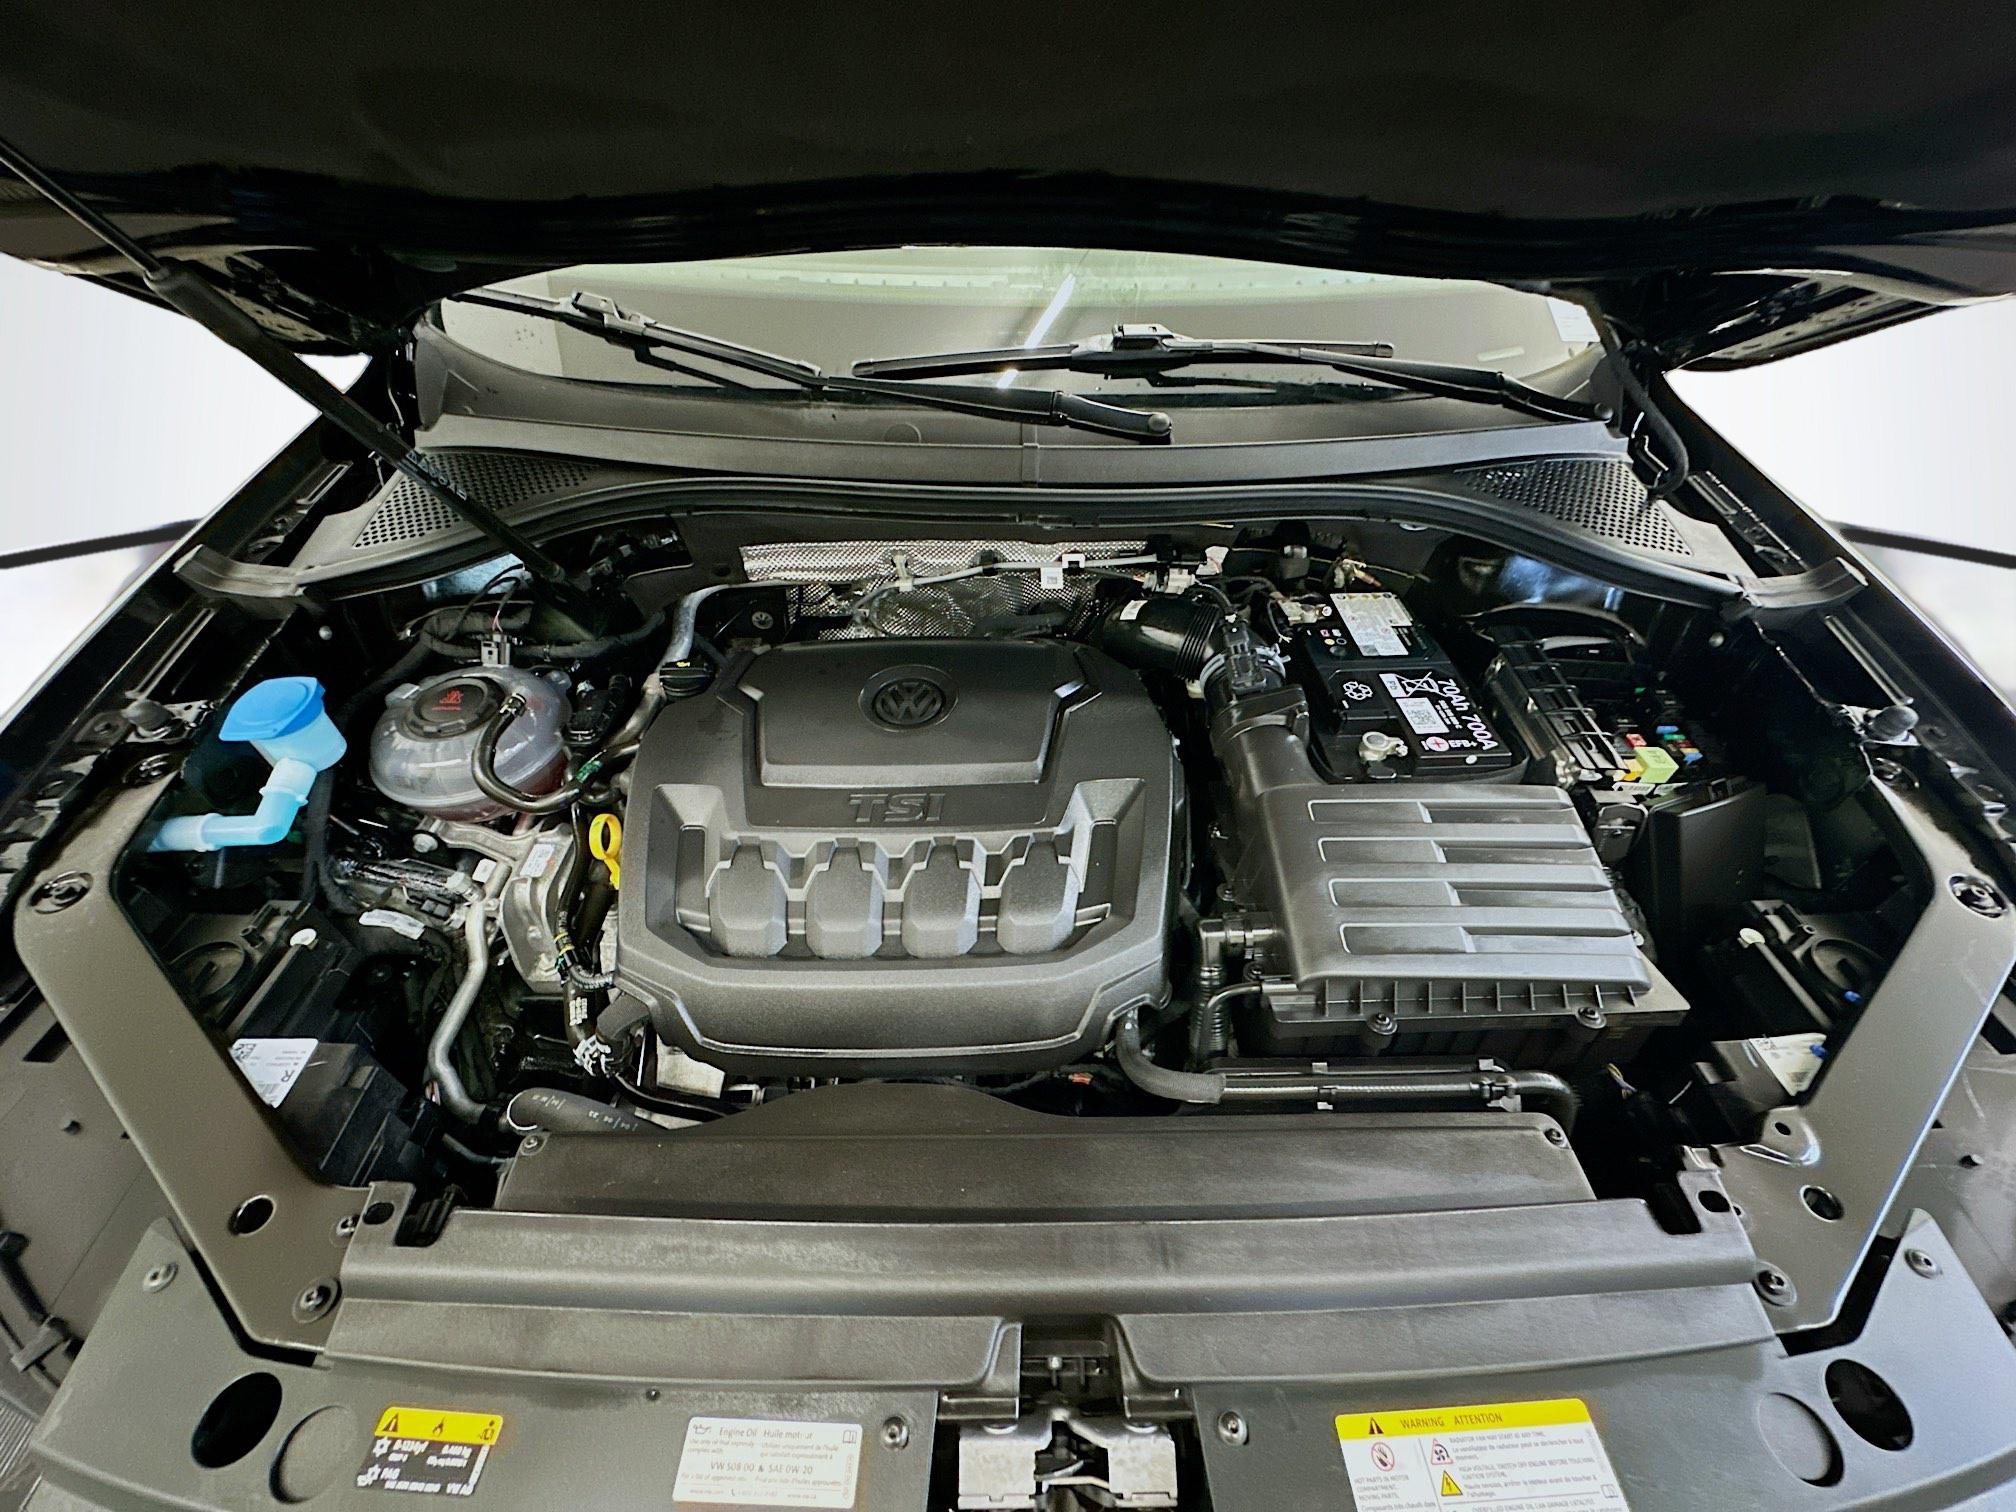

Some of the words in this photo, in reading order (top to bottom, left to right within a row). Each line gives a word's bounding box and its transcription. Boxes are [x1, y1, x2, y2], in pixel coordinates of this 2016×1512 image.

[1437, 679, 1470, 711] 70Ah
[1461, 714, 1499, 751] 700A
[850, 793, 945, 822] TSI
[1400, 1416, 1445, 1429] WARNING
[1454, 1413, 1503, 1426] ATTENTION
[719, 1427, 744, 1438] Engine
[746, 1428, 757, 1437] Oil
[763, 1429, 784, 1439] Huile
[711, 1461, 725, 1471] VW
[768, 1464, 785, 1473] SAE
